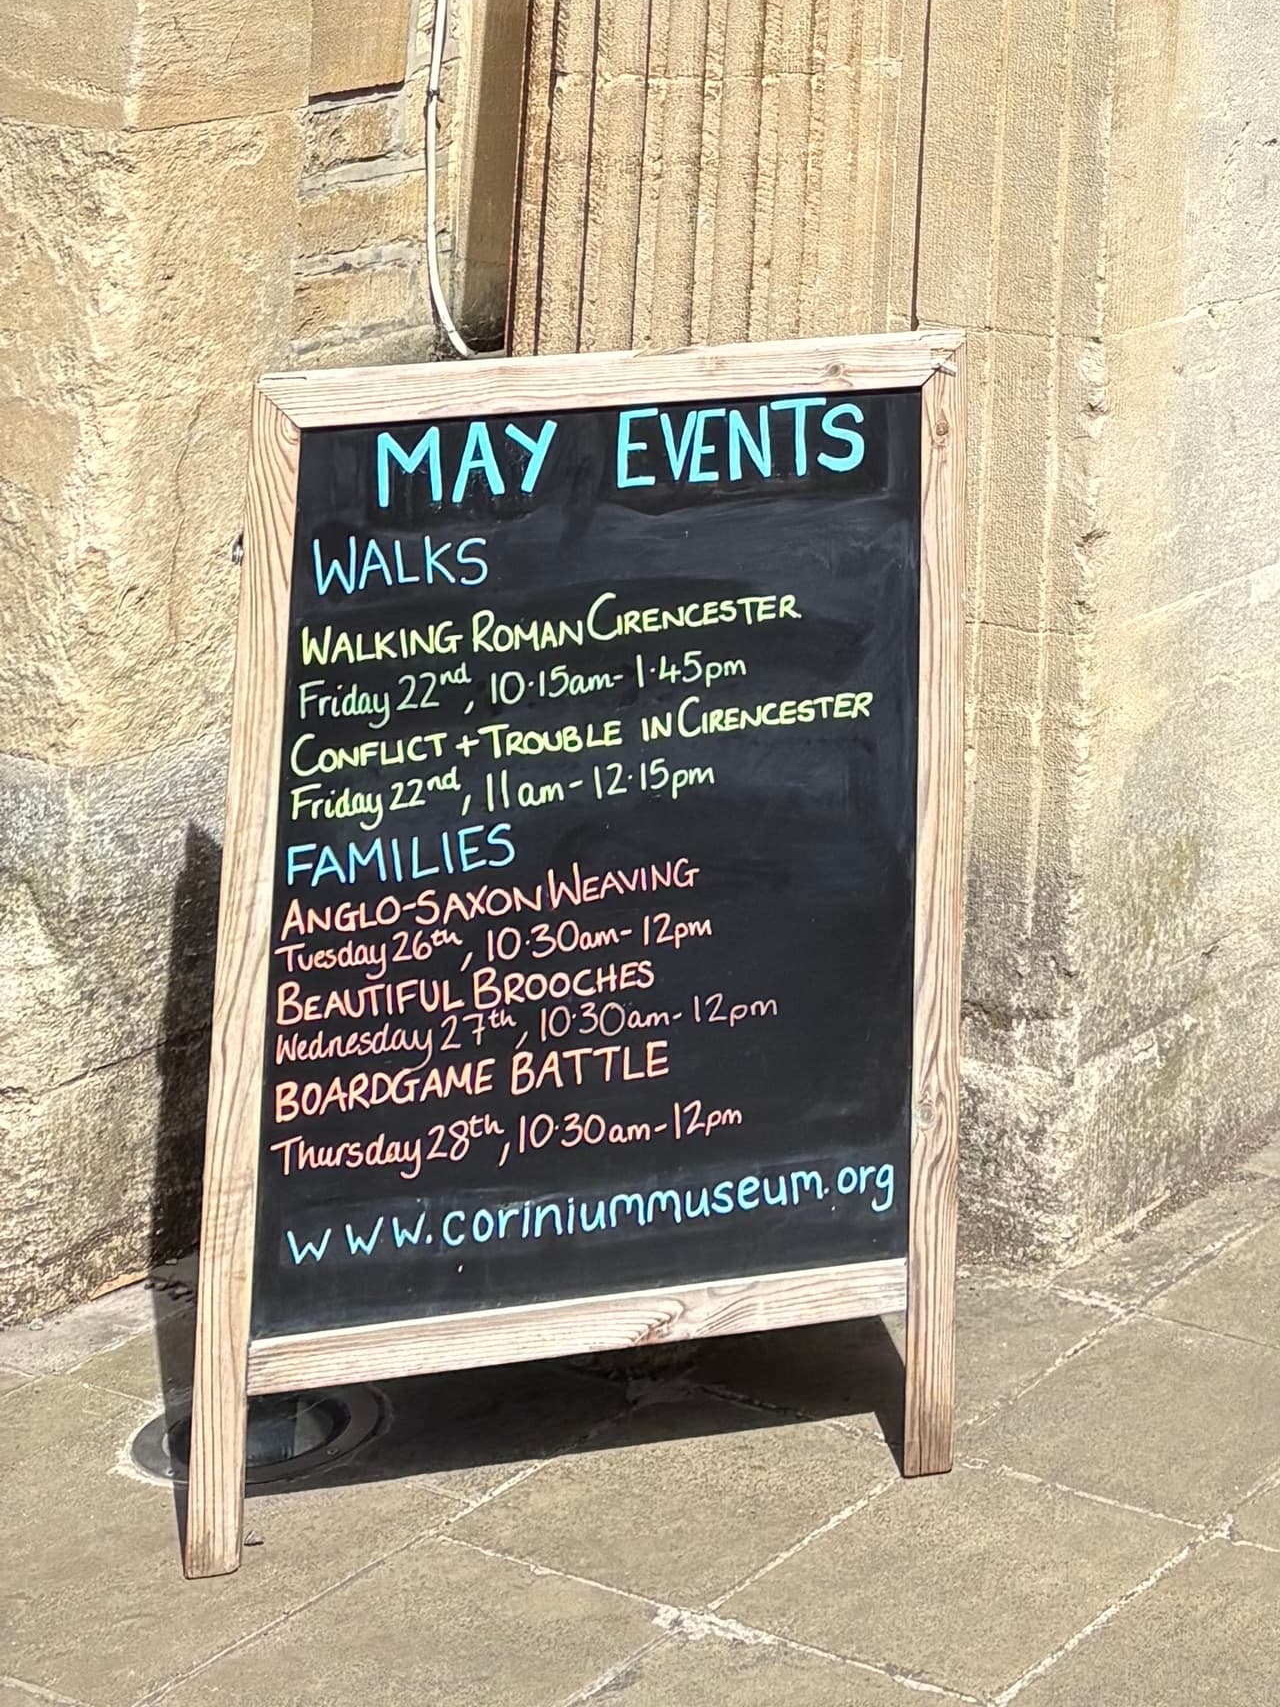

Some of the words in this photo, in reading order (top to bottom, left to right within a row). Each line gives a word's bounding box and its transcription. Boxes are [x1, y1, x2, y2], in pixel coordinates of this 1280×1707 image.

[377, 420, 557, 507] MAY
[617, 397, 864, 488] EVENTS
[313, 536, 488, 595] WALKS
[302, 621, 463, 665] WALKING
[472, 610, 583, 652] ROMAN
[587, 592, 802, 640] CIRENCESTER
[291, 733, 447, 776] CONFLICT
[456, 735, 479, 757] +
[477, 721, 622, 758] TROUBLE
[642, 712, 672, 742] IN
[678, 692, 873, 737] CIRENCESTER
[299, 680, 390, 728] Friday
[291, 783, 383, 830] Friday
[288, 823, 515, 886] FAMILIES
[281, 885, 542, 942] ANGLO-SAXON
[548, 858, 699, 909] WEAVING
[274, 940, 386, 980] Tuesday
[644, 913, 712, 949] 12pm
[277, 979, 464, 1025] BEAUTIFUL
[473, 961, 654, 1010] BROOCHES
[275, 1023, 432, 1071] Wednesday
[695, 993, 777, 1027] 12pm
[276, 1058, 495, 1123] BOARDGAME
[511, 1041, 669, 1095] BATTLE
[270, 1133, 421, 1179] Thursday
[287, 1164, 894, 1264] www.coriniummuseum.org
